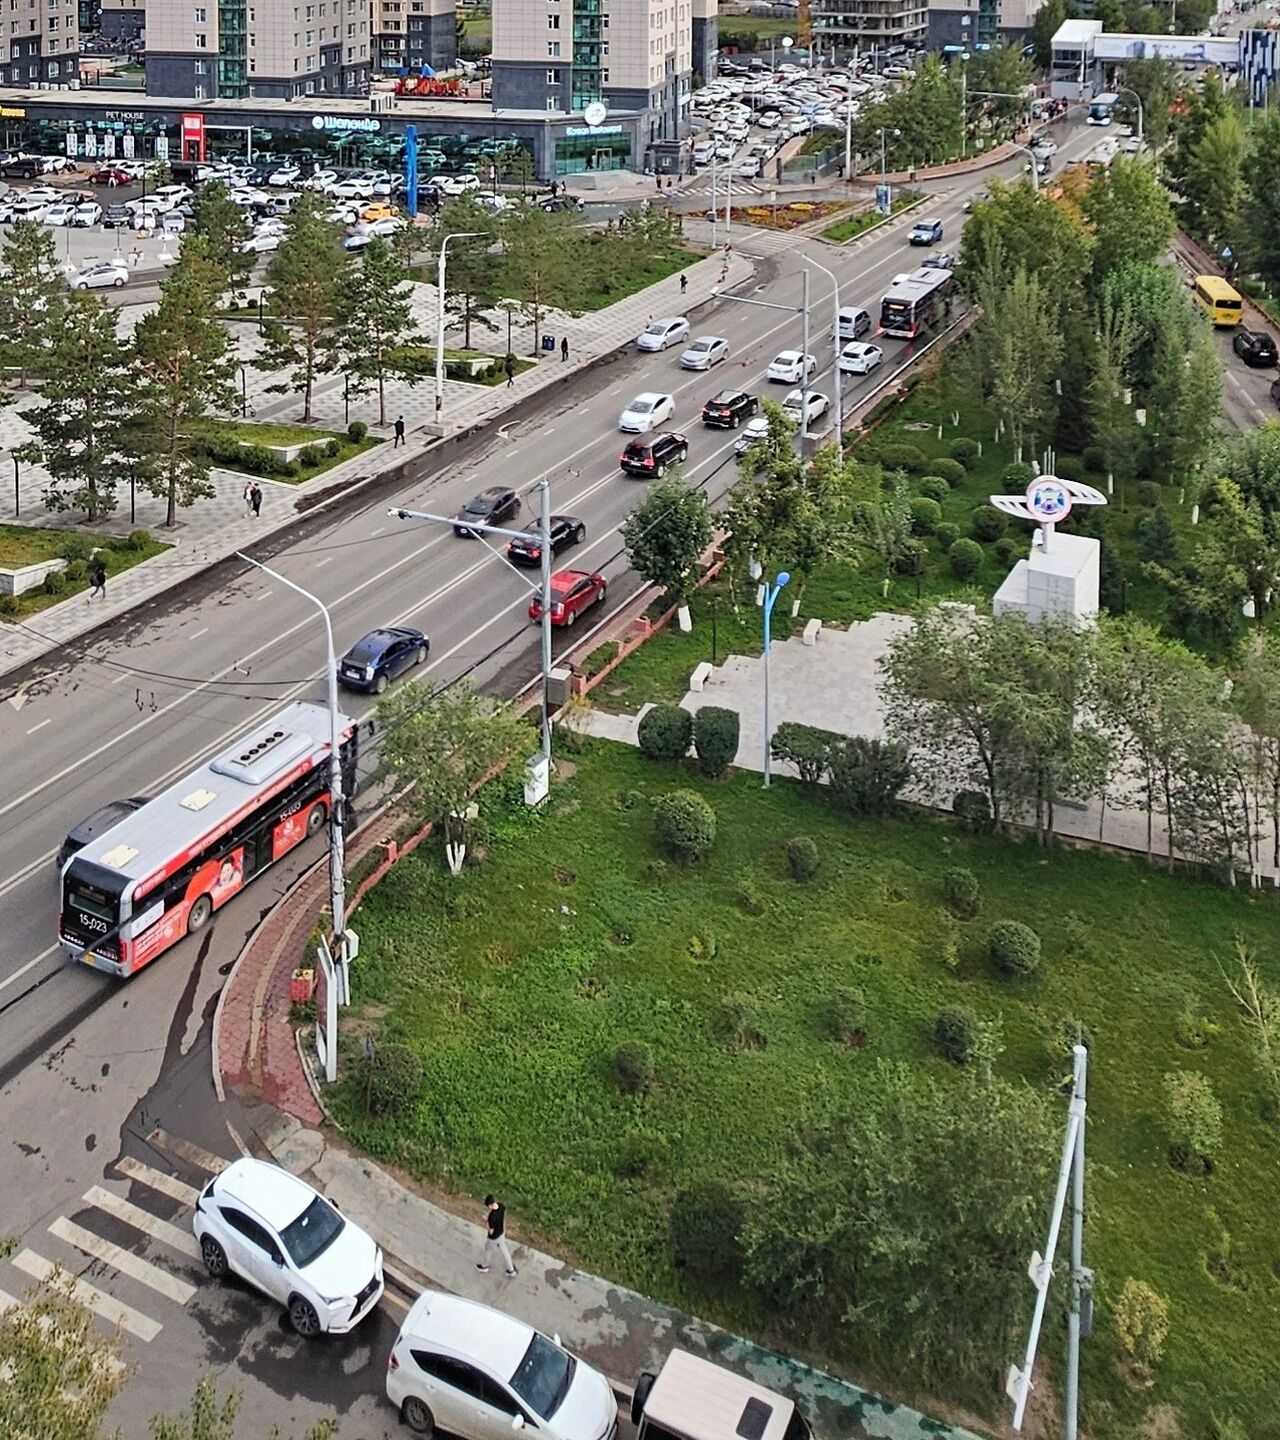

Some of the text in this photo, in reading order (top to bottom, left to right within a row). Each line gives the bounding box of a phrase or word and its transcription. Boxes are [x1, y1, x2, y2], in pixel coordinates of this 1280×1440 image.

[105, 111, 119, 120] PET
[121, 111, 145, 120] HOUSE
[79, 912, 108, 934] 15-023
